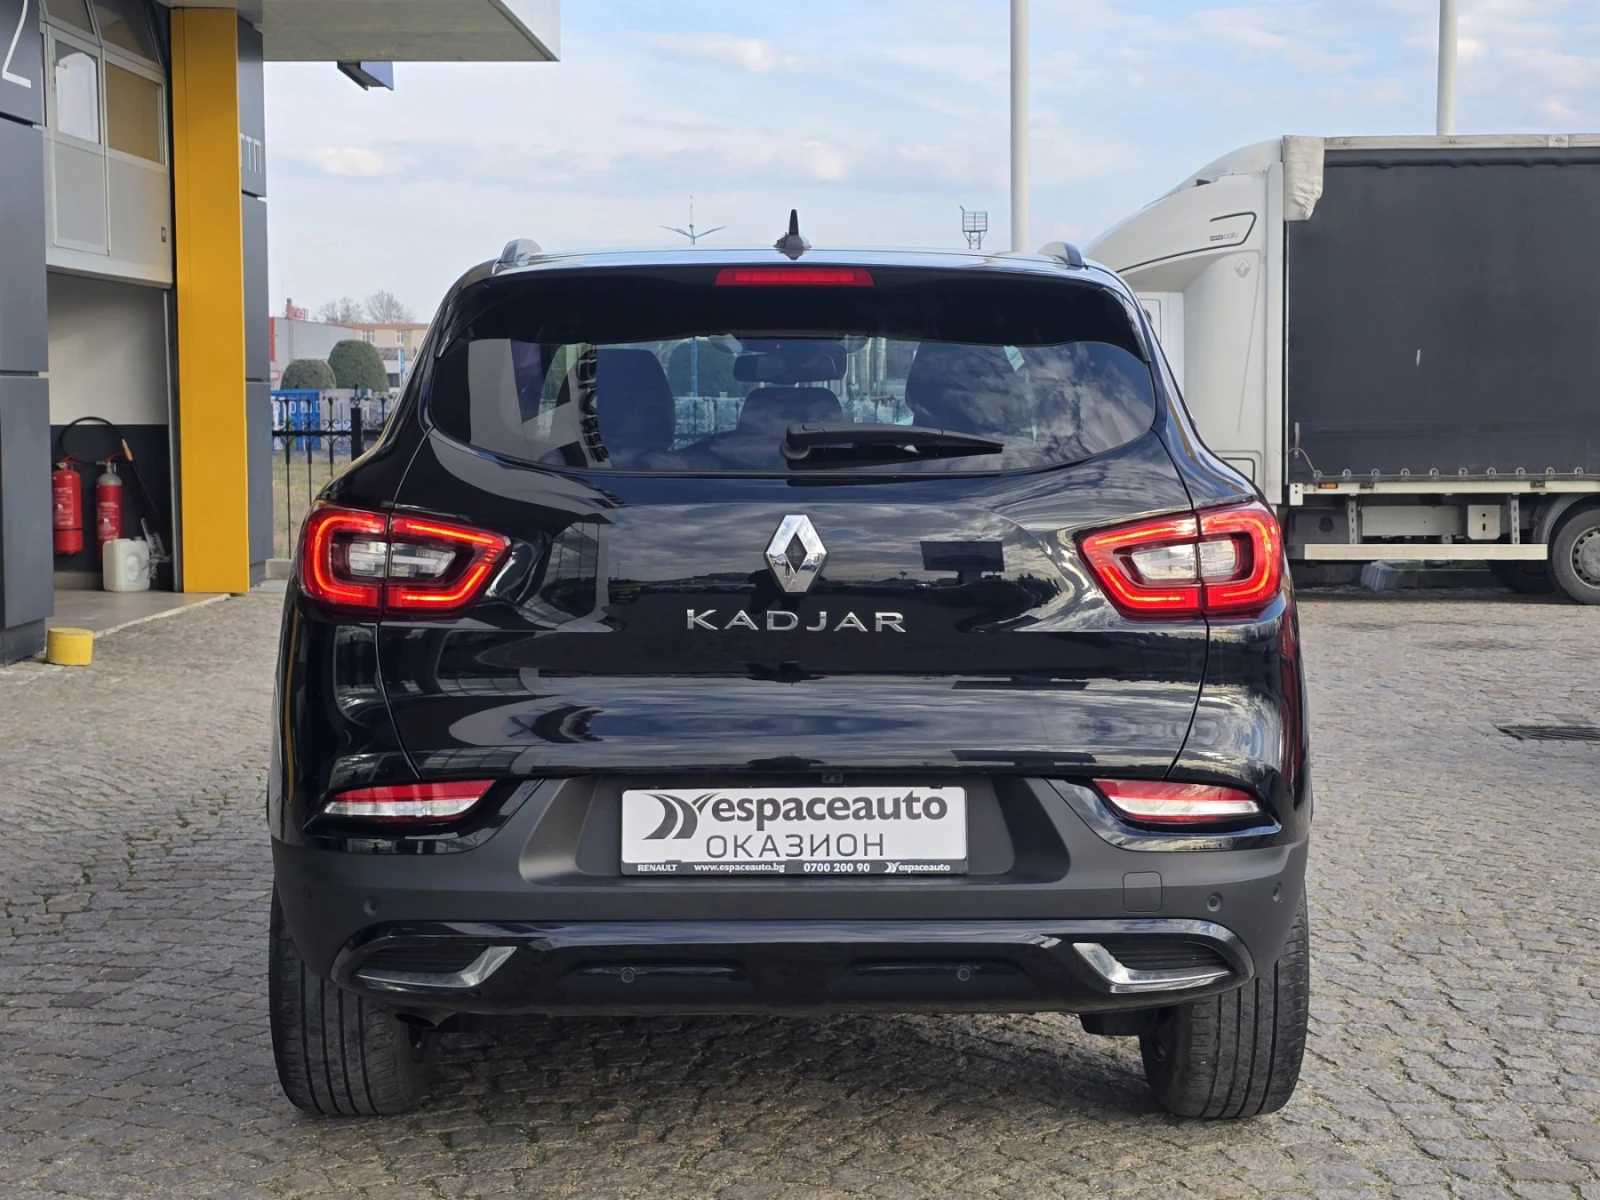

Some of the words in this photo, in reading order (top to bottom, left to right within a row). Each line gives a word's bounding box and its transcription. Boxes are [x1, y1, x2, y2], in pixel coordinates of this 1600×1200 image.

[686, 609, 907, 633] KADJAR
[711, 790, 948, 832] espaceauto
[706, 833, 884, 859] ОКАЗИОН
[637, 863, 678, 872] RENAULT
[694, 862, 786, 873] www.espaceauto.bg
[803, 862, 831, 872] 0700
[833, 862, 854, 872] 200
[857, 862, 871, 872] 90
[898, 862, 951, 873] espaceauto
